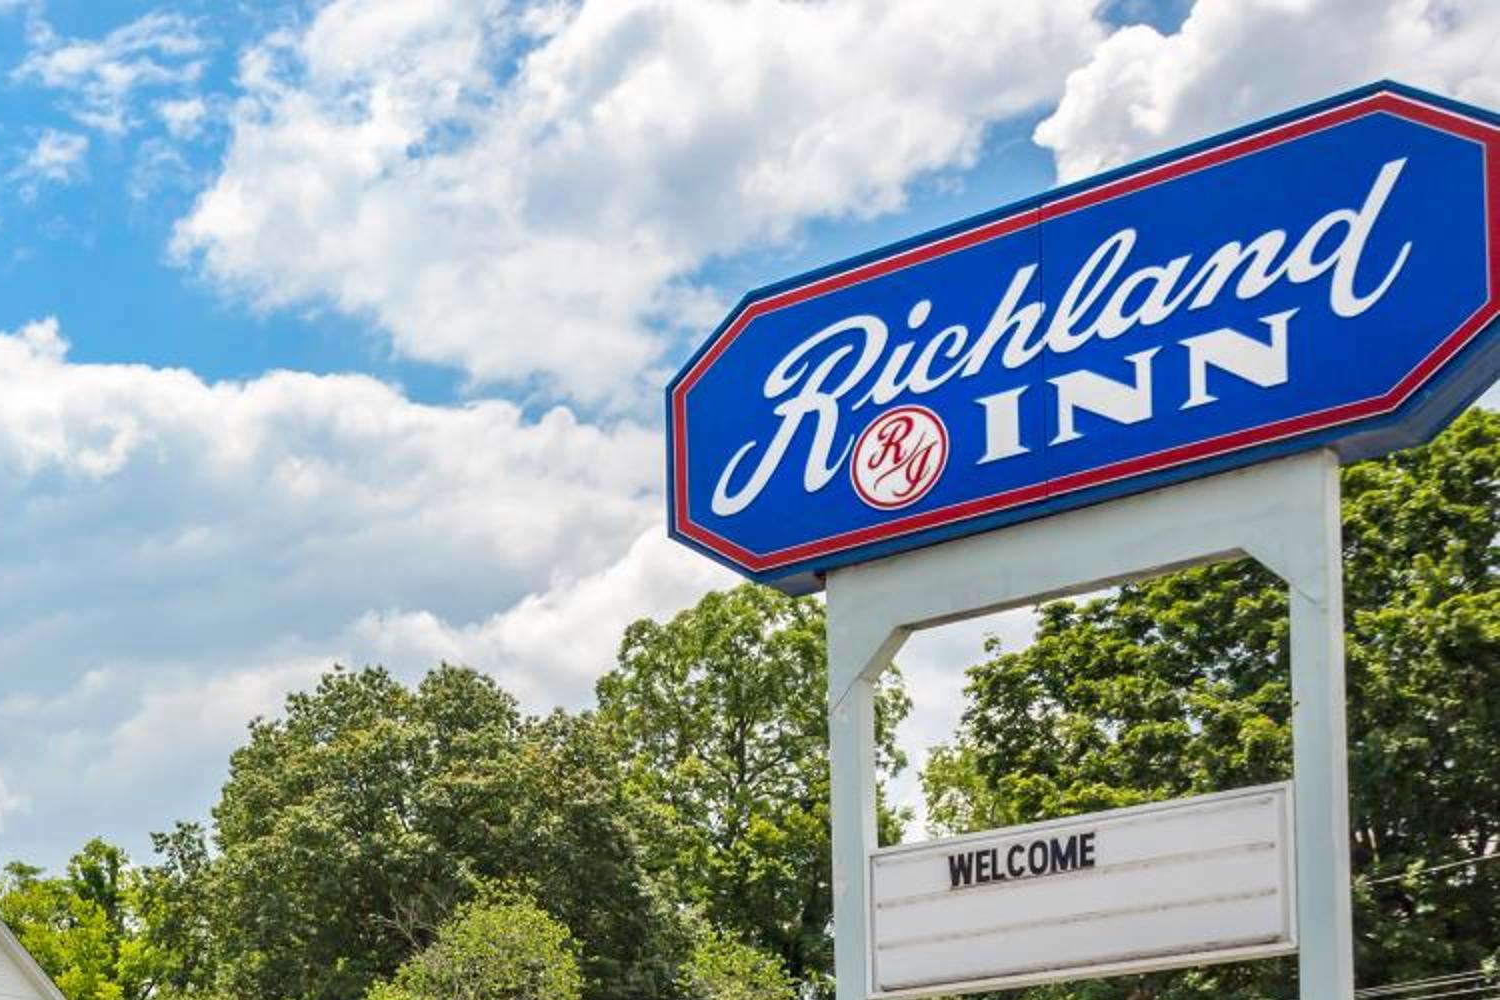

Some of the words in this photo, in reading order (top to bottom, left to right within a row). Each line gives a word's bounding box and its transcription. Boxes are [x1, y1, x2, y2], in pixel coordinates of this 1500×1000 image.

[711, 157, 1412, 517] Richland
[976, 310, 1299, 465] INN
[948, 832, 1096, 887] WELCOME
